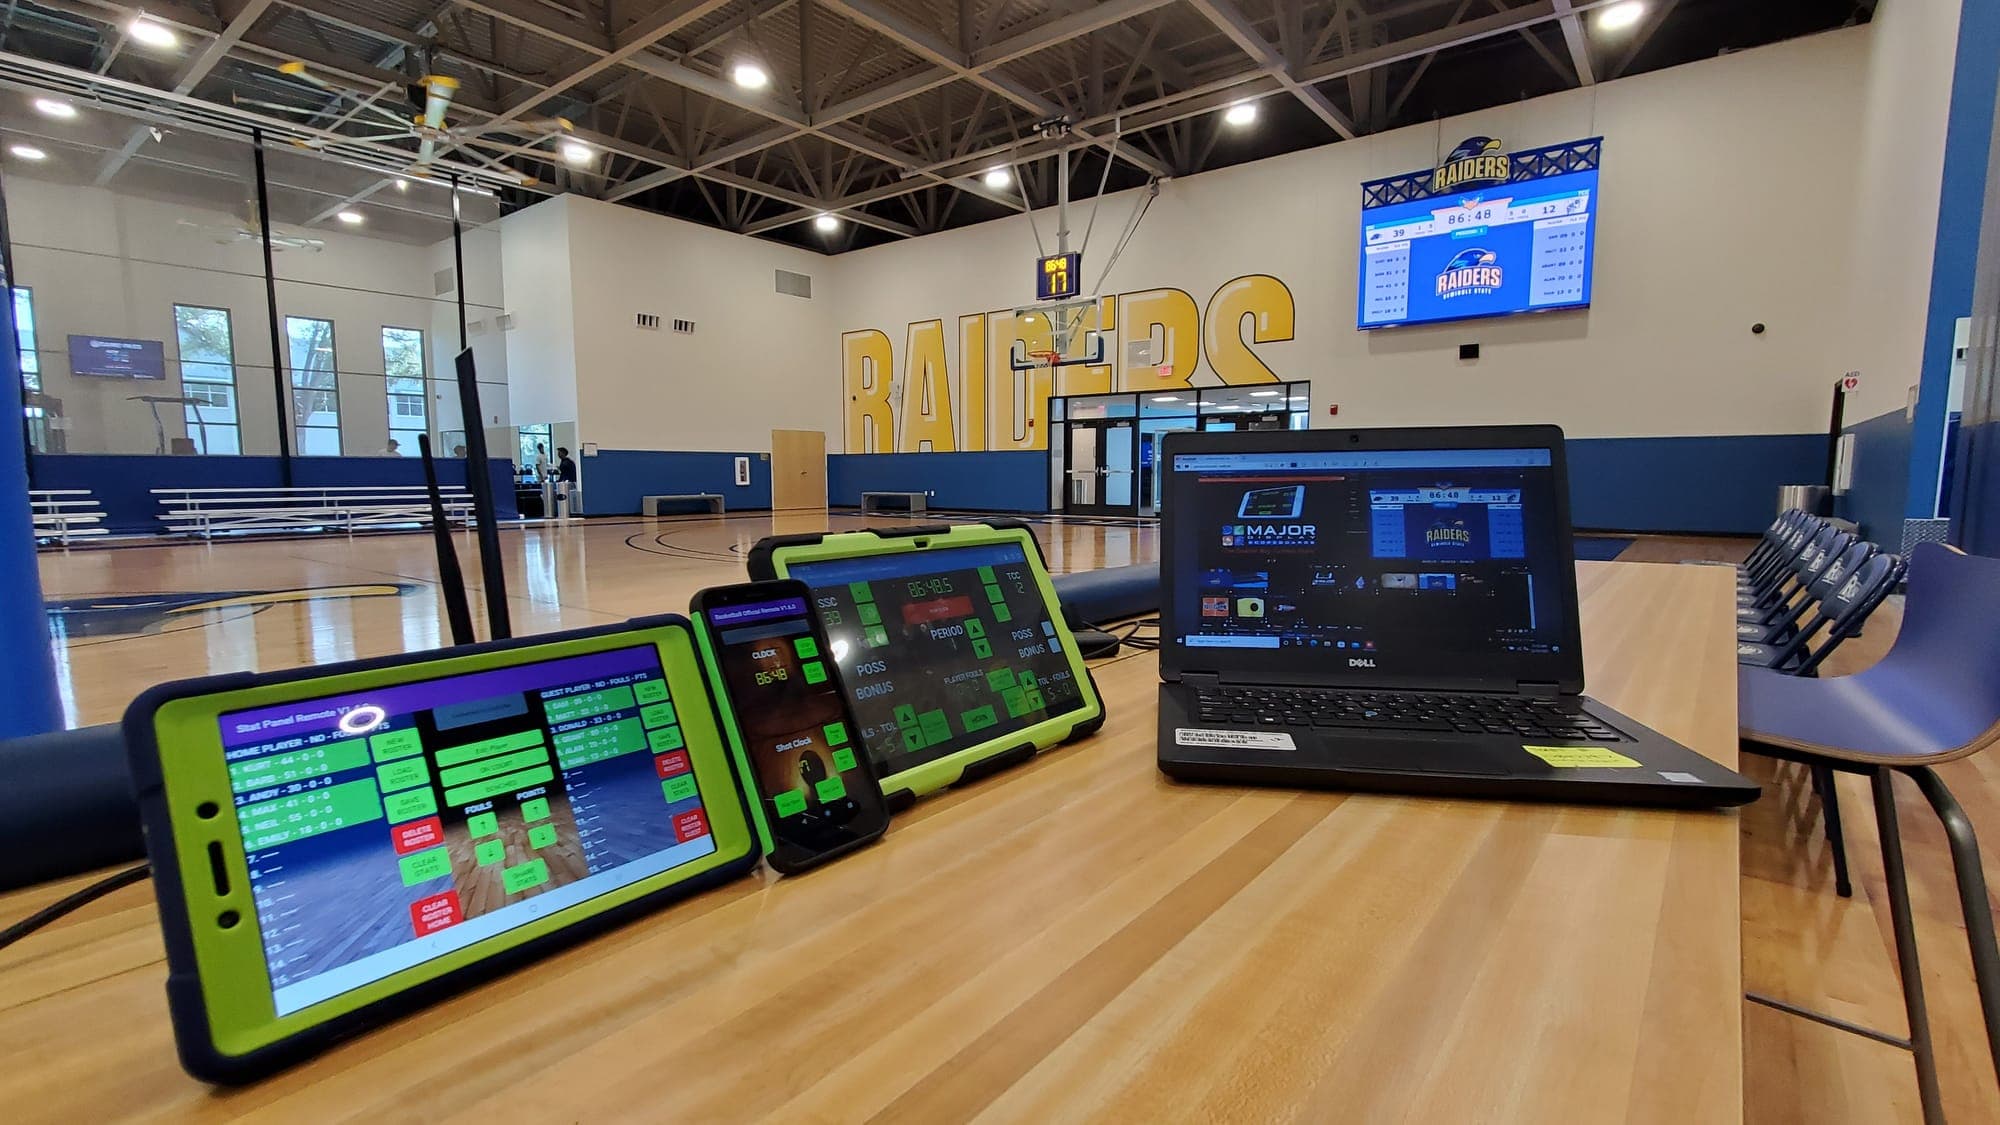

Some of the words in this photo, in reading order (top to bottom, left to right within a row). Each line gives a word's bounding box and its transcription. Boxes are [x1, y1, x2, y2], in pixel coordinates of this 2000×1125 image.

[1435, 155, 1509, 190] RAIDERS
[1393, 228, 1405, 238] 39
[1448, 209, 1492, 225] 86:48
[1543, 204, 1556, 214] 12
[1051, 271, 1067, 294] 17
[1438, 266, 1502, 293] RAIDERS
[842, 274, 1296, 455] RAIDERS
[1247, 524, 1316, 536] MAJOR
[1426, 528, 1470, 542] RAIDERS
[818, 596, 838, 608] SSC
[930, 625, 964, 640] PERIOD
[1011, 628, 1034, 640] POSS
[752, 648, 777, 659] CLOCK
[1018, 643, 1046, 658] BONUS
[856, 661, 887, 677] POSS
[1349, 658, 1376, 668] DELL
[755, 668, 788, 686] 86:48
[541, 688, 564, 699] GUEST
[565, 683, 591, 694] PLAYER
[595, 680, 606, 688] NO
[609, 675, 631, 685] FOULS
[634, 672, 648, 681] PTS
[856, 681, 894, 700] BONUS
[236, 723, 261, 734] Stat
[262, 716, 294, 729] Panel
[296, 709, 337, 723] Remote
[226, 747, 261, 760] HOME
[262, 738, 303, 753] PLAYER
[309, 734, 326, 744] NO
[776, 742, 793, 753] Shot
[793, 736, 813, 748] Clock
[302, 753, 309, 761] 0
[317, 750, 325, 758] 0
[305, 766, 313, 775] 0
[320, 763, 328, 772] 0
[249, 789, 279, 802] ANDY
[309, 780, 317, 788] 0
[324, 776, 332, 785] 0
[516, 786, 546, 800] POINTS
[252, 804, 278, 817] MAX
[308, 794, 315, 803] 0
[322, 791, 330, 800] 0
[464, 800, 493, 814] FOULS
[254, 819, 279, 831] NEIL
[310, 809, 318, 817] 0
[325, 805, 333, 814] 0
[681, 814, 698, 825] CLEAR
[257, 831, 290, 845] EMILY
[320, 821, 328, 829] 0
[335, 817, 343, 826] 0
[412, 856, 437, 869] CLEAR
[421, 899, 449, 913] CLEAR
